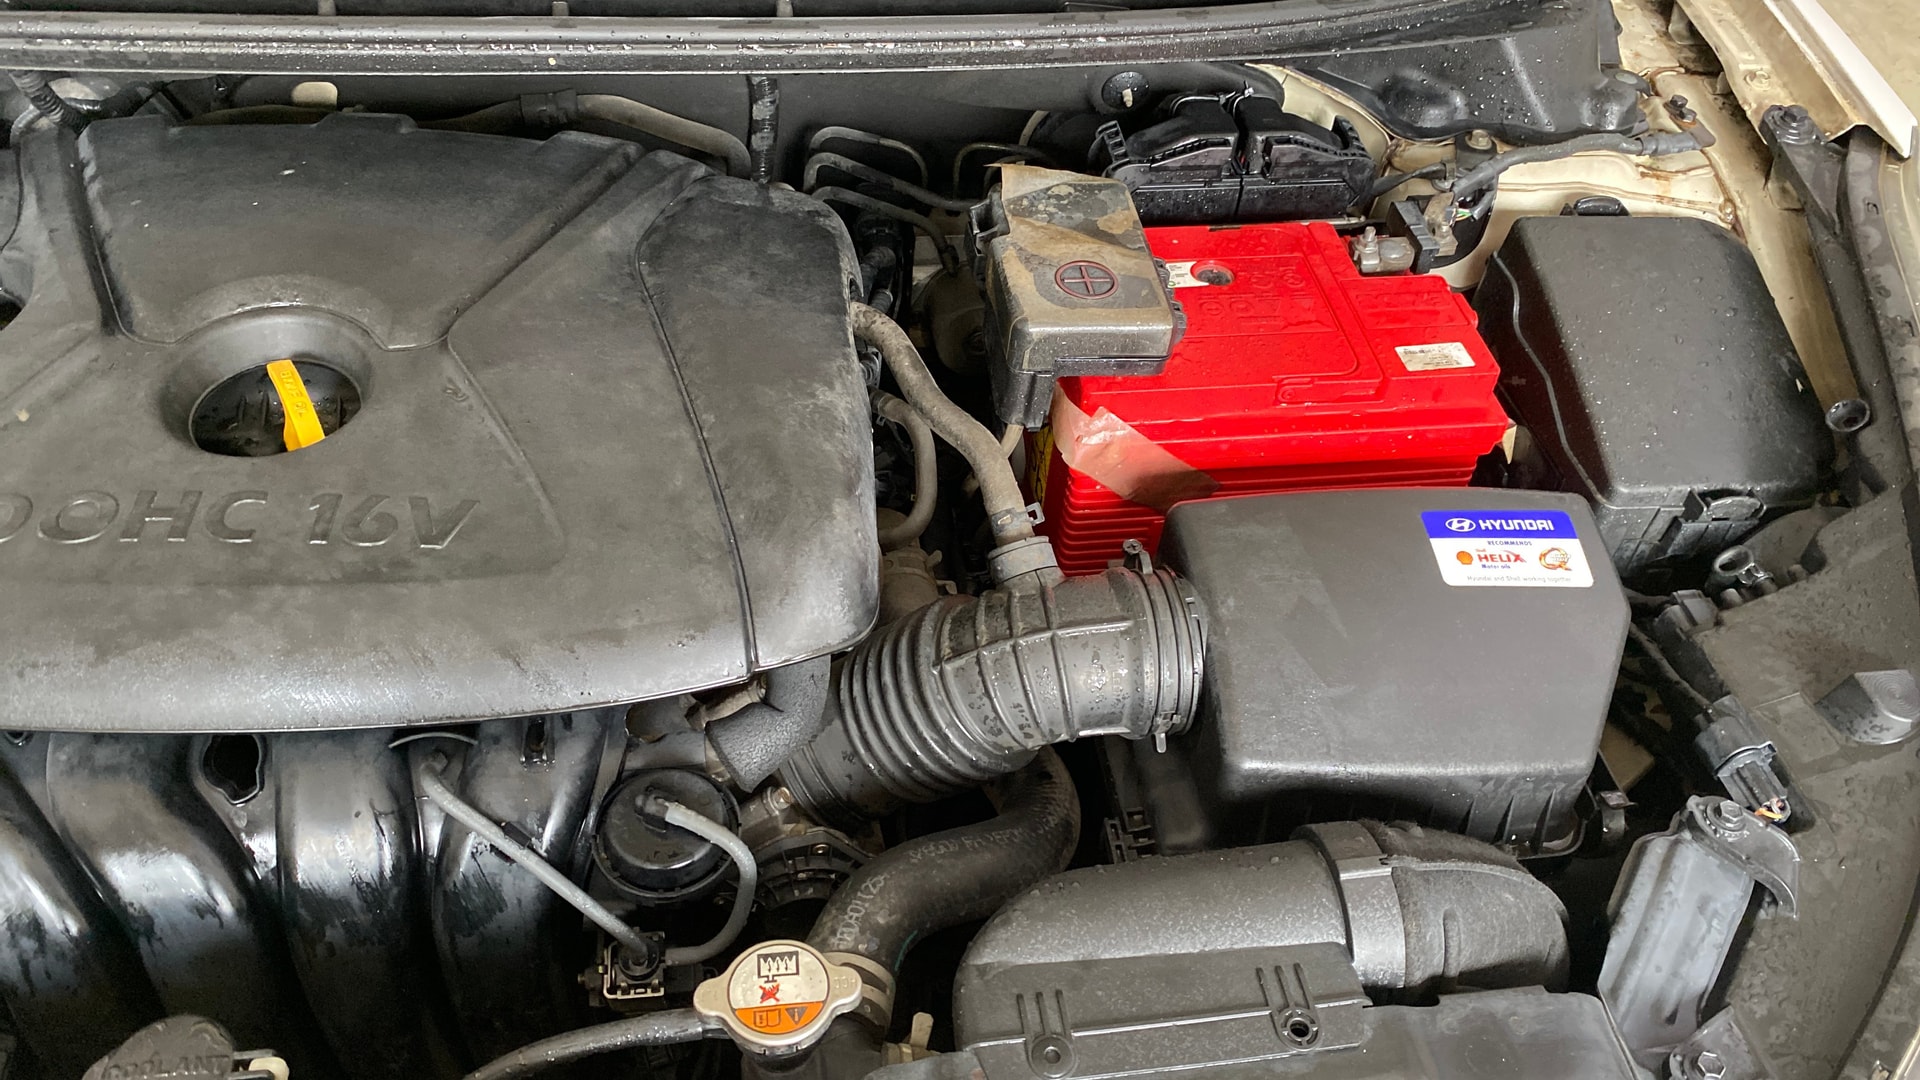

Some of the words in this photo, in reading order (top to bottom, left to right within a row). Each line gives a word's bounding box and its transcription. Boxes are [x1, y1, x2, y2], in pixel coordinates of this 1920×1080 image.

[308, 493, 480, 549] 16V
[1478, 519, 1555, 531] HYUNDAI
[1477, 552, 1527, 563] HELIX
[1467, 575, 1492, 583] Hyundai
[1493, 575, 1505, 583] and
[1523, 575, 1546, 583] working
[1547, 575, 1572, 584] together
